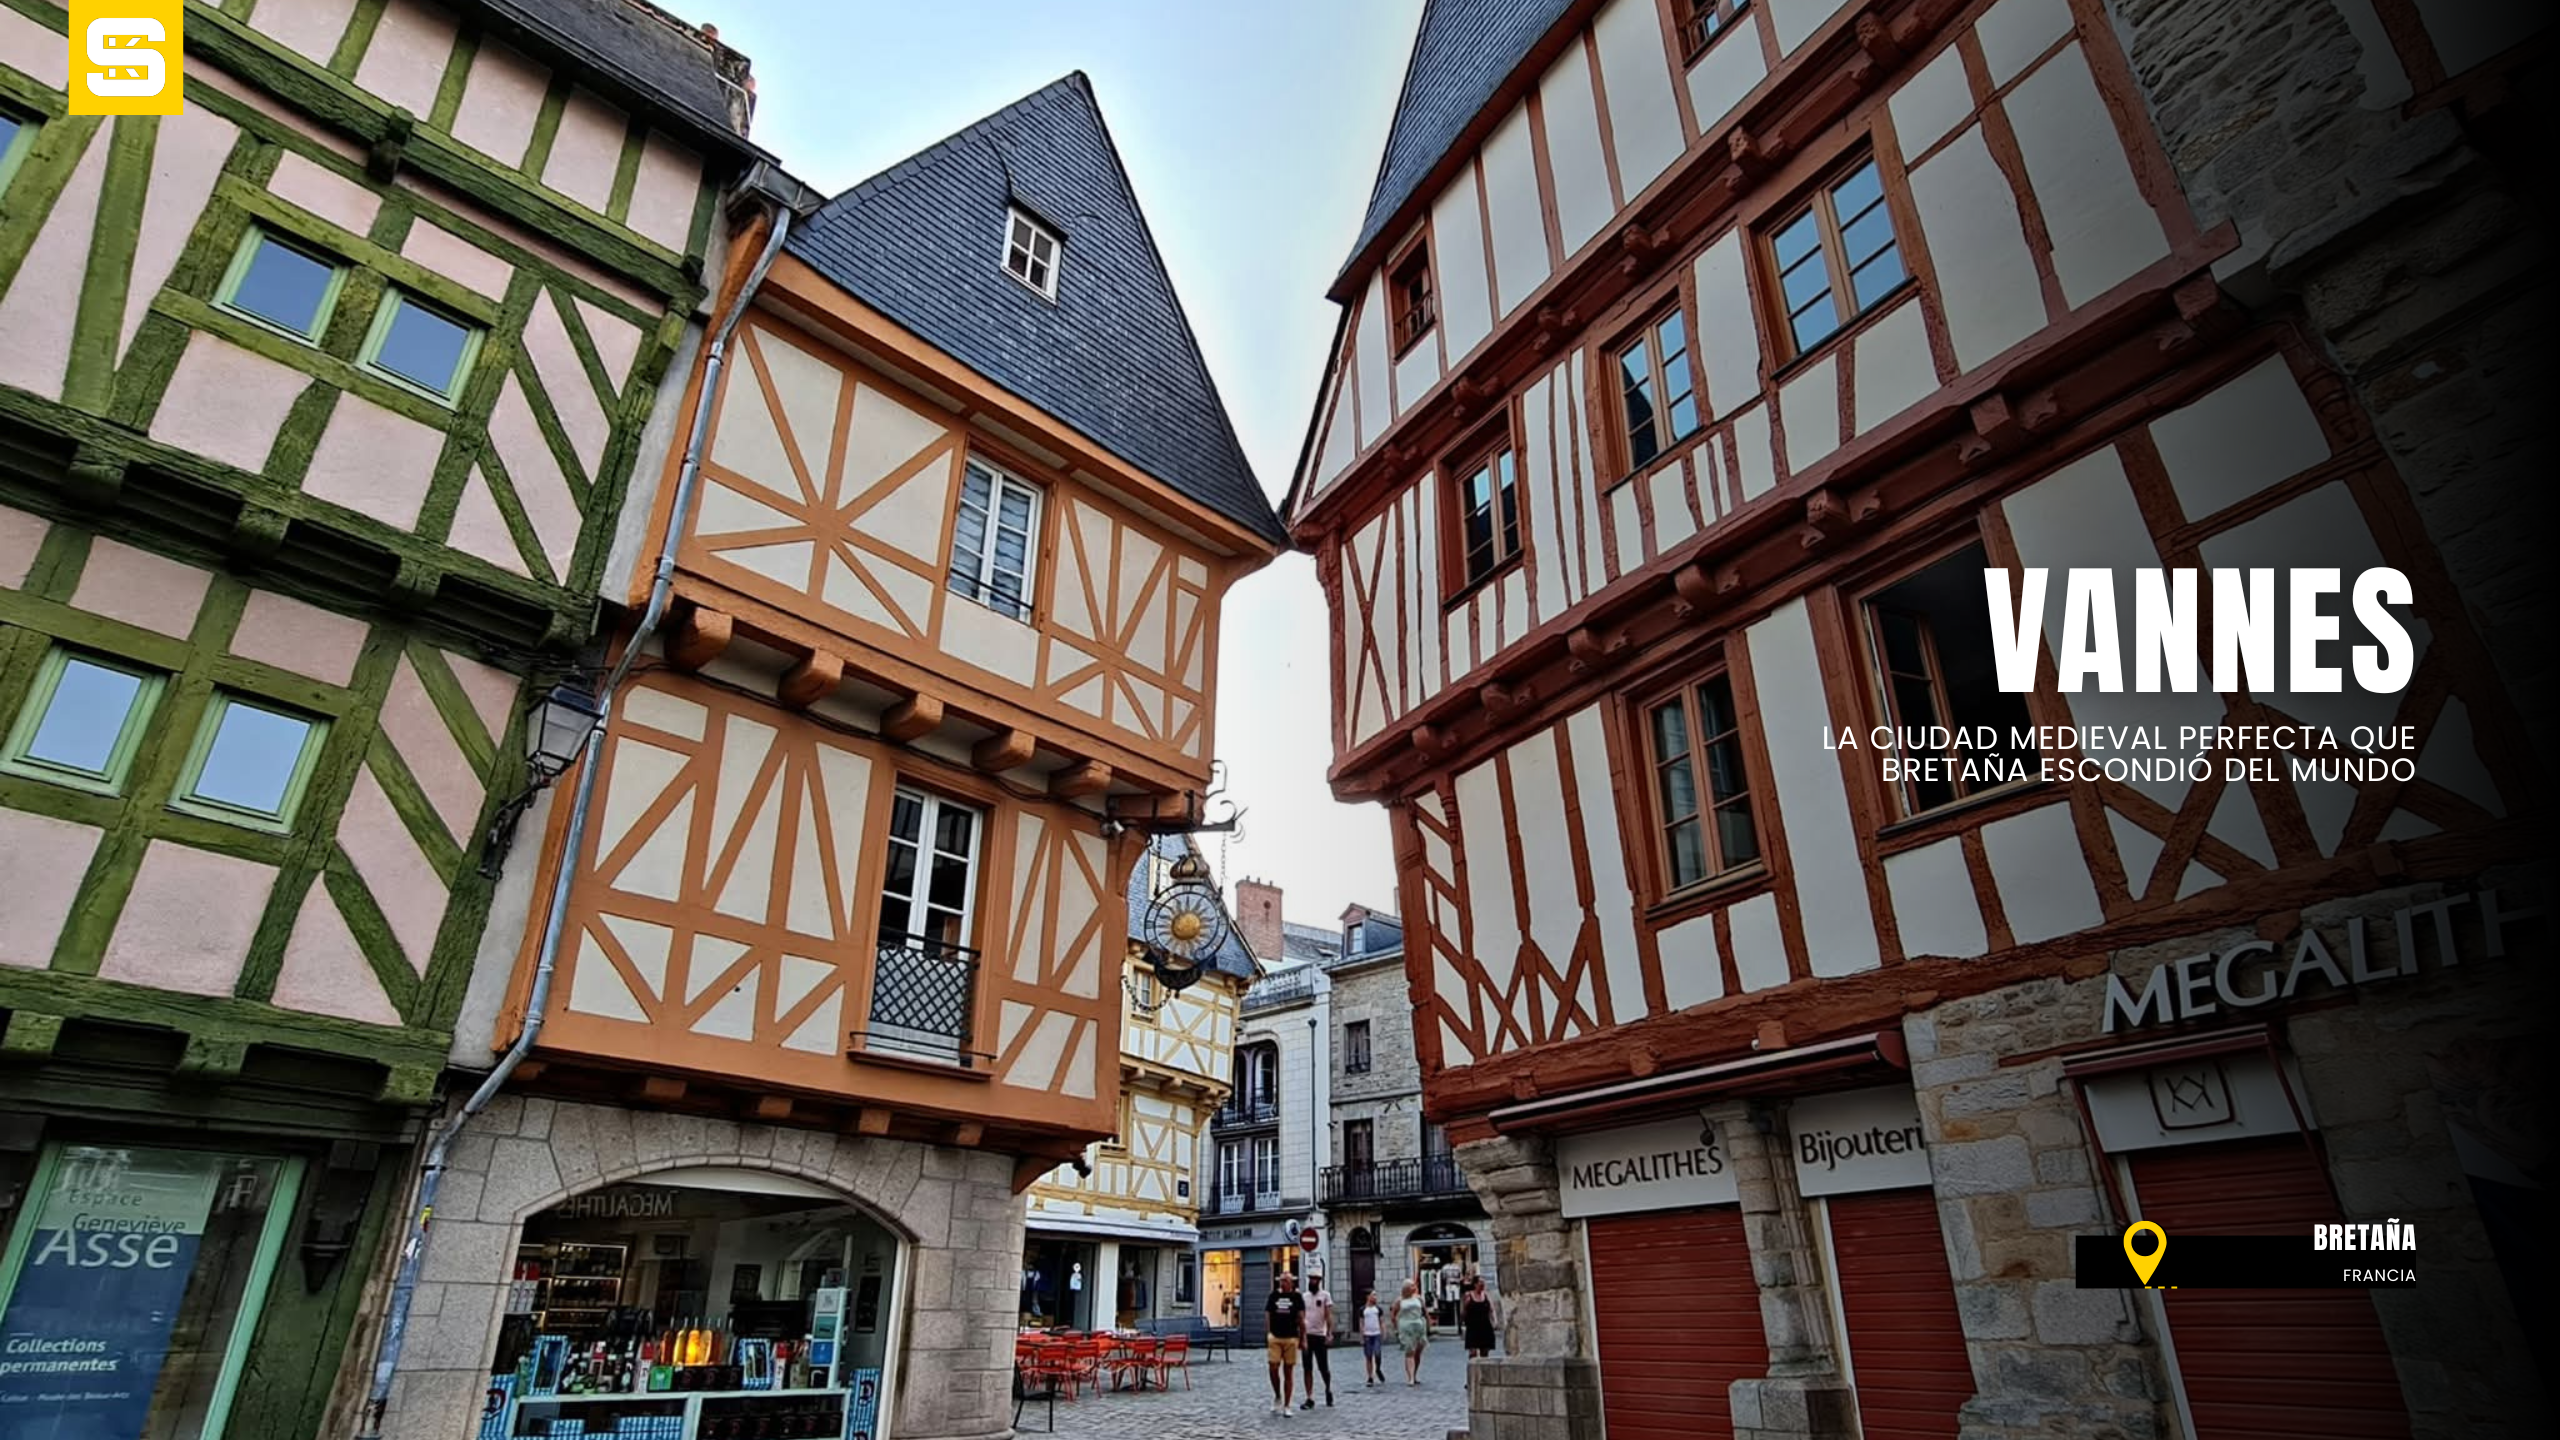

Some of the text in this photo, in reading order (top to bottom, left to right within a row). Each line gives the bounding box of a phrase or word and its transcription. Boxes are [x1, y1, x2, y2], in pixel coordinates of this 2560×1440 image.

[1573, 1147, 1723, 1190] MEGALITHES
[70, 1189, 142, 1206] Espace
[73, 1213, 186, 1234] Geneviève
[34, 1228, 178, 1269] Asse
[6, 1338, 107, 1354] Collections
[0, 1358, 118, 1376] permanentes
